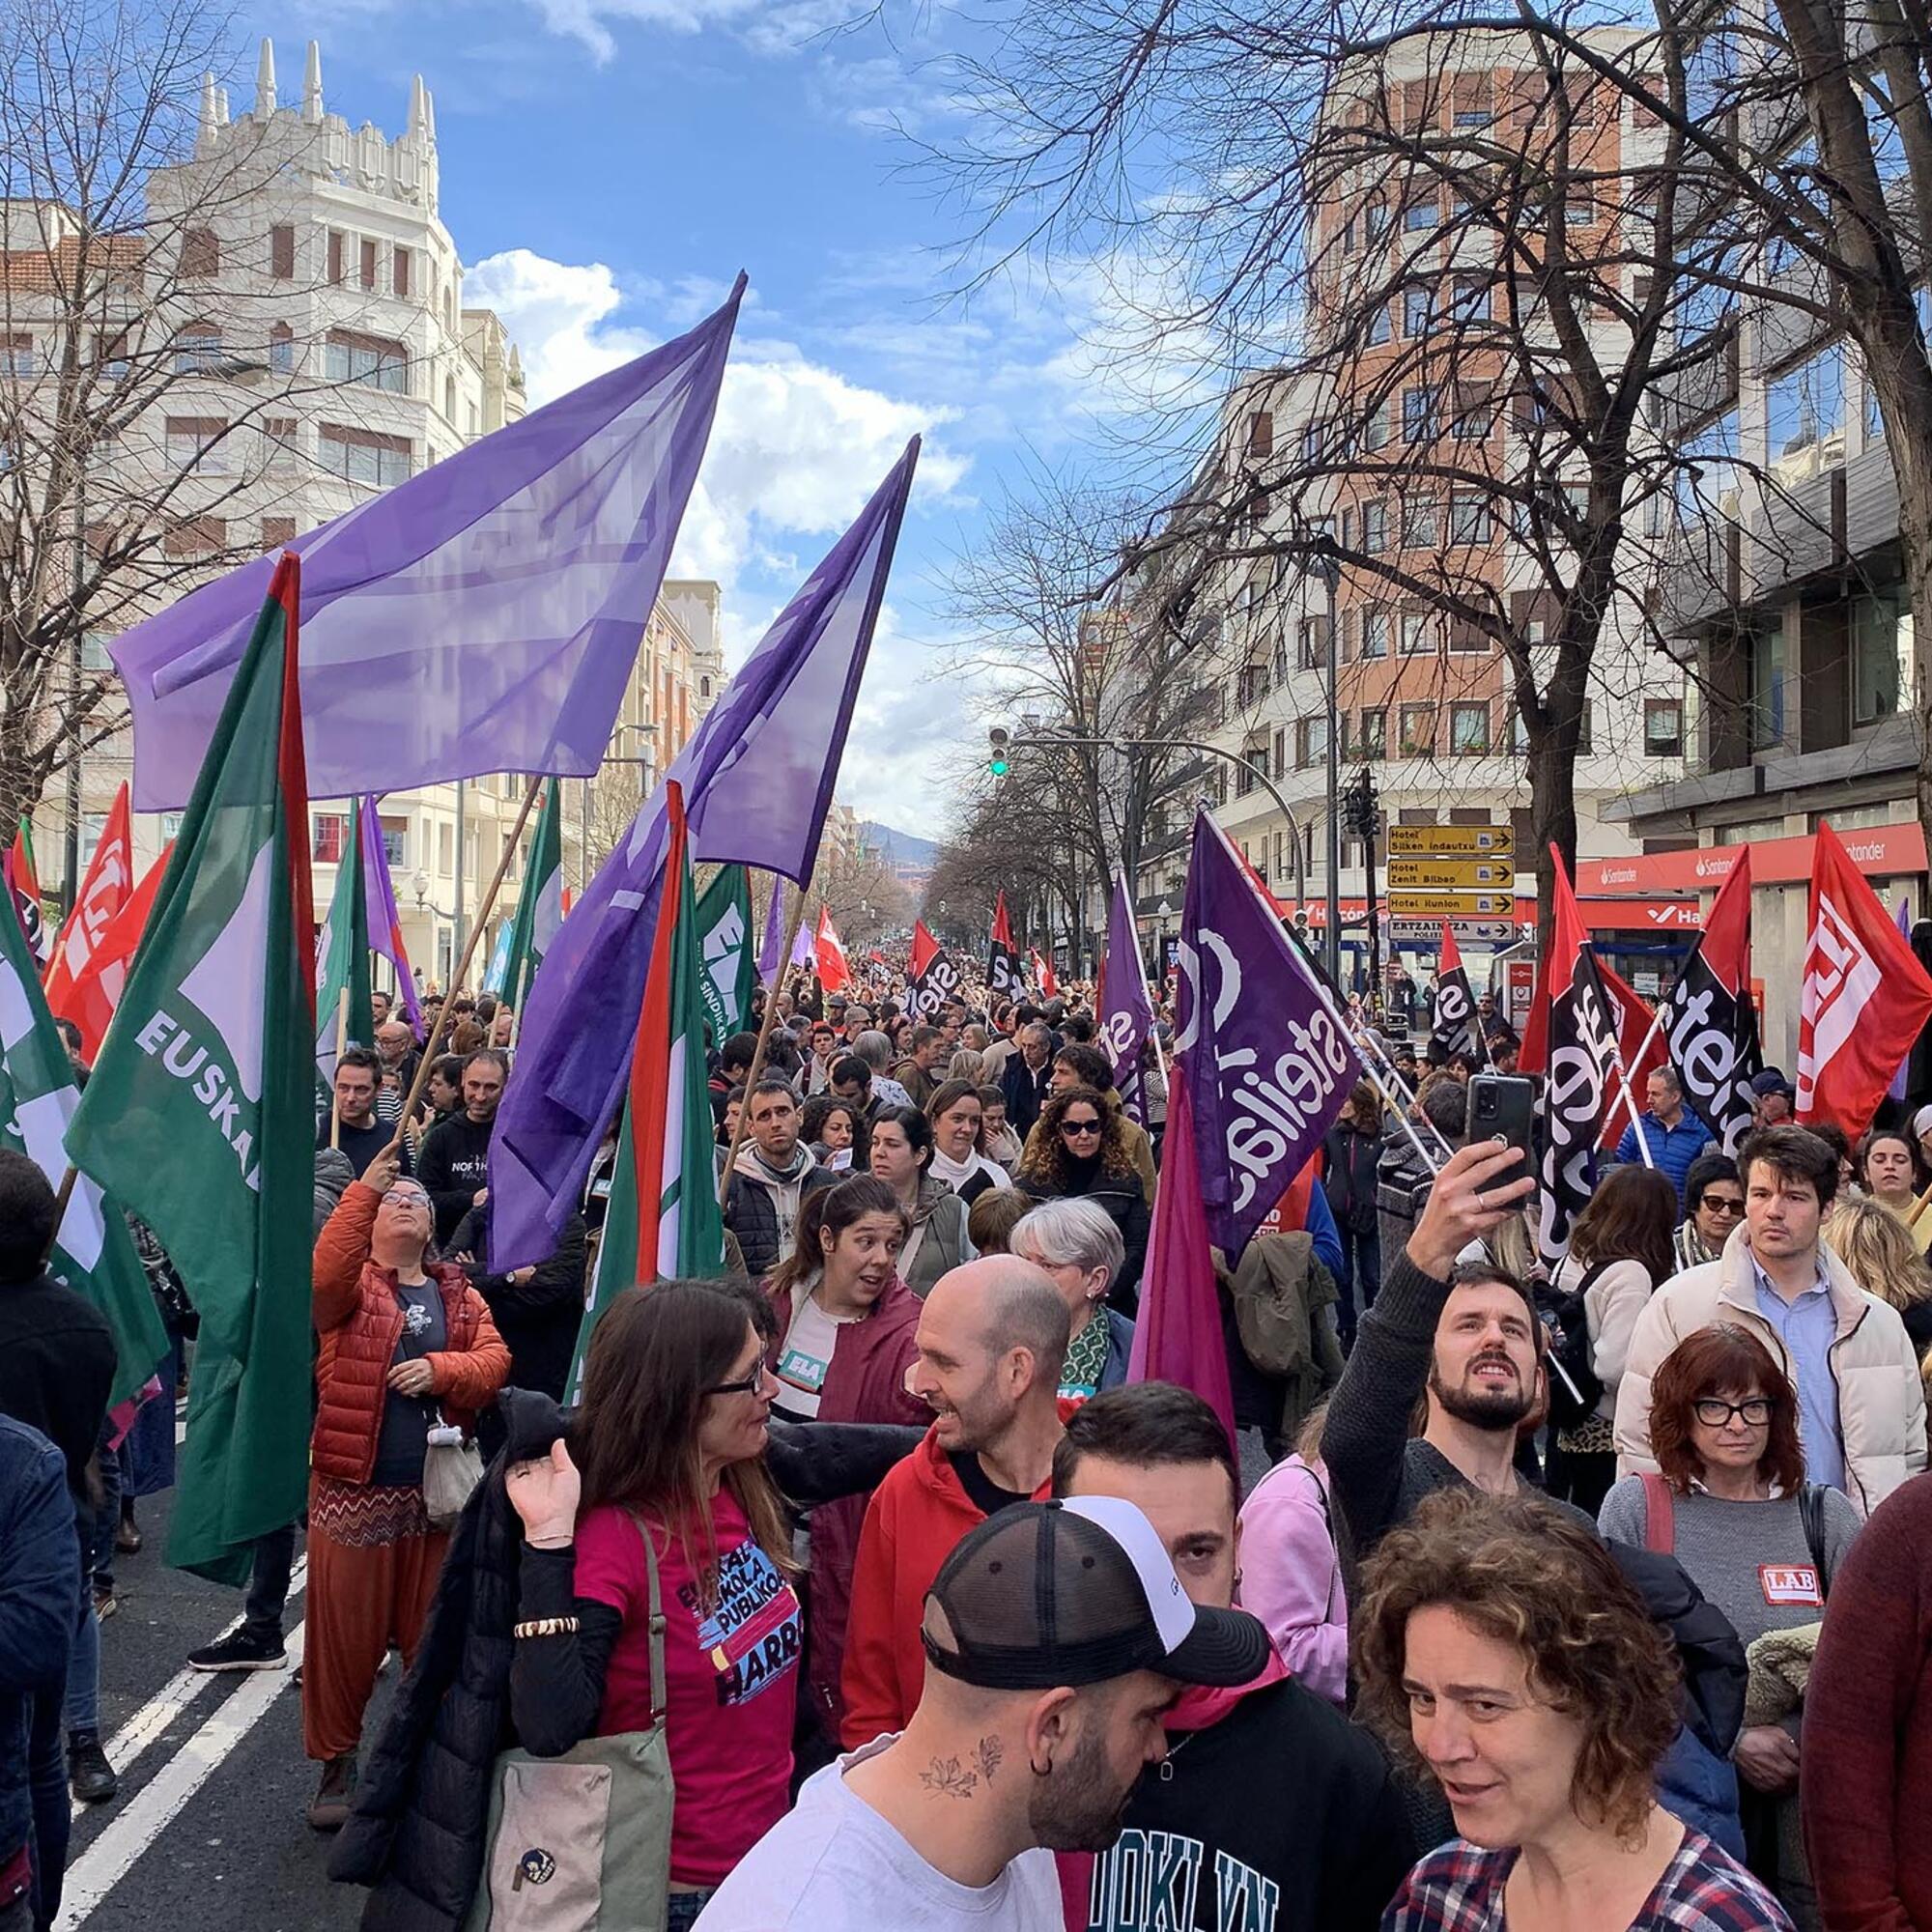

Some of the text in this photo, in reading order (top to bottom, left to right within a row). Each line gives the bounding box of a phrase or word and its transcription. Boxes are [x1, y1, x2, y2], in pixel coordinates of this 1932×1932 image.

[1845, 839, 1886, 862] ntander
[1607, 867, 1636, 883] Santander
[788, 1355, 820, 1380] ELA
[1768, 1573, 1814, 1591] LAB
